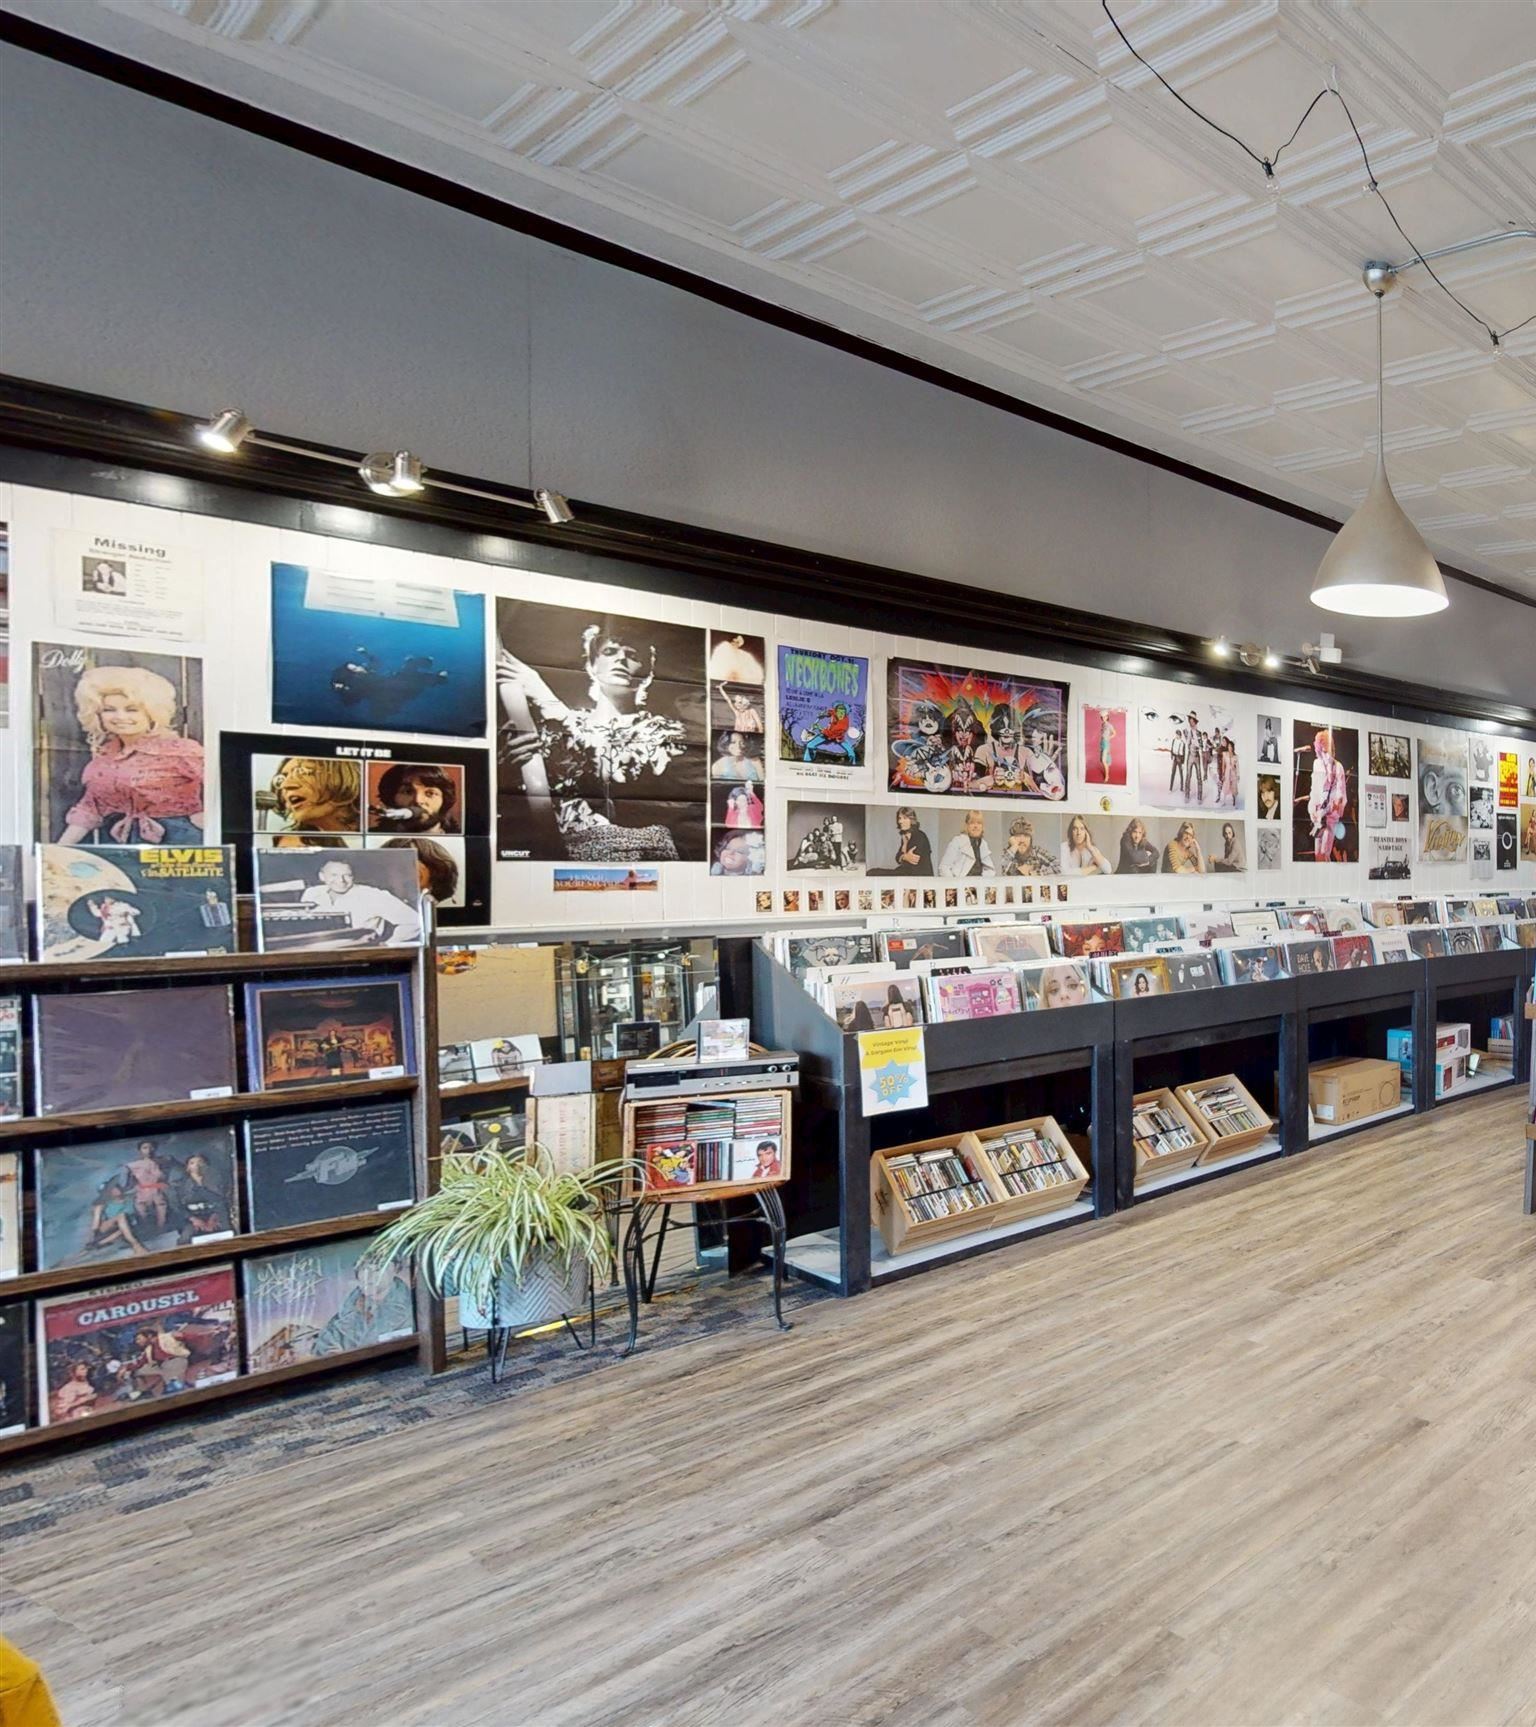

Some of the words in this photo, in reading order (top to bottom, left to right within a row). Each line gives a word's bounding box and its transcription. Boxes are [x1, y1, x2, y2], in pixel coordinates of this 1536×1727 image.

[94, 537, 167, 558] Missing
[41, 648, 88, 673] Dolly
[784, 653, 859, 698] NECKBONES
[336, 746, 360, 757] LET
[361, 747, 373, 757] IT
[374, 748, 392, 758] BE
[139, 848, 223, 864] ELVIS
[501, 850, 531, 858] UNCUT
[880, 1074, 908, 1088] 50%
[882, 1084, 903, 1096] OFF
[77, 1290, 200, 1325] CAROUSEL
